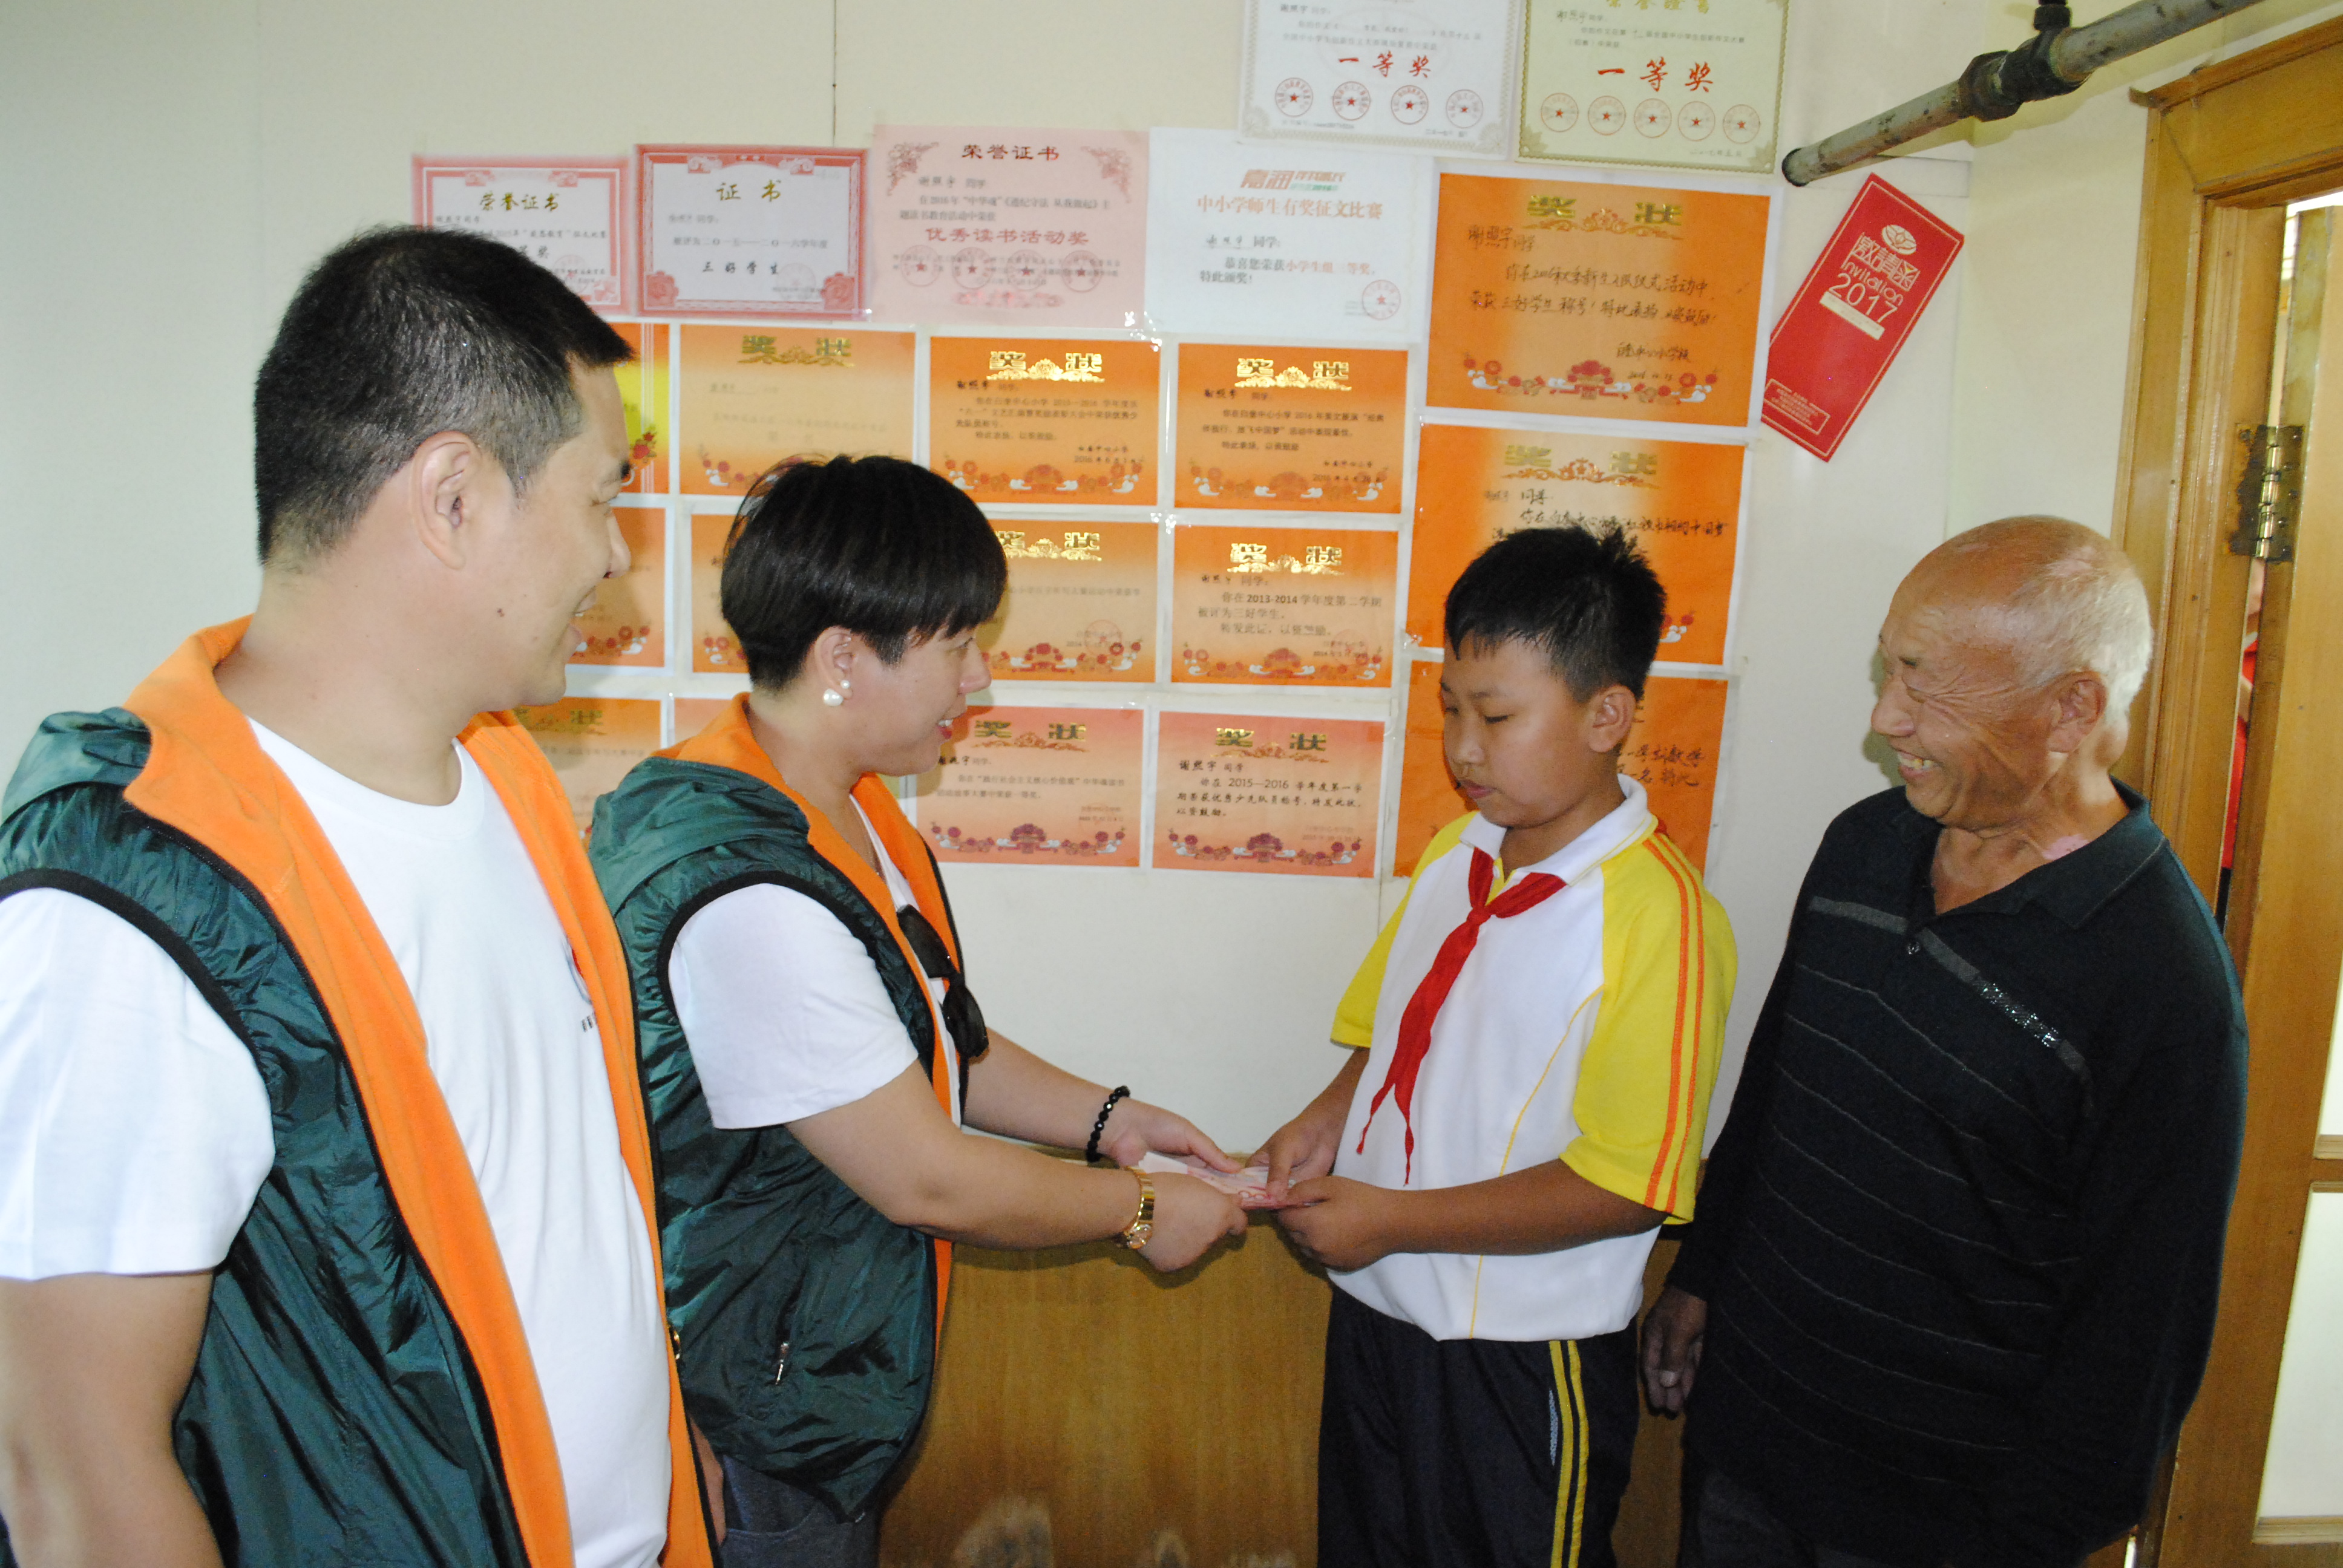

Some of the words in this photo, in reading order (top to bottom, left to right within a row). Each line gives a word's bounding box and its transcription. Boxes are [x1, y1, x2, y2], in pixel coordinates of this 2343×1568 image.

[1338, 50, 1430, 79] 一等奖
[1597, 57, 1713, 93] 一等奖
[962, 145, 1060, 161] 荣誉证书
[480, 191, 559, 212] 荣誉证书
[715, 180, 782, 202] 证书
[1198, 195, 1383, 219] 中小学师生有奖征文比赛
[1527, 195, 1682, 226] 奖状
[925, 227, 1089, 246] 优秀读书活动奖
[1829, 273, 1898, 322] 2017
[741, 335, 851, 357] 奖状
[989, 351, 1102, 373] 奖状
[1237, 358, 1349, 380] 奖状
[1505, 445, 1657, 474] 奖状
[1230, 543, 1342, 566] 奖状
[975, 720, 1086, 741] 奖状
[1216, 727, 1327, 751] 奖状
